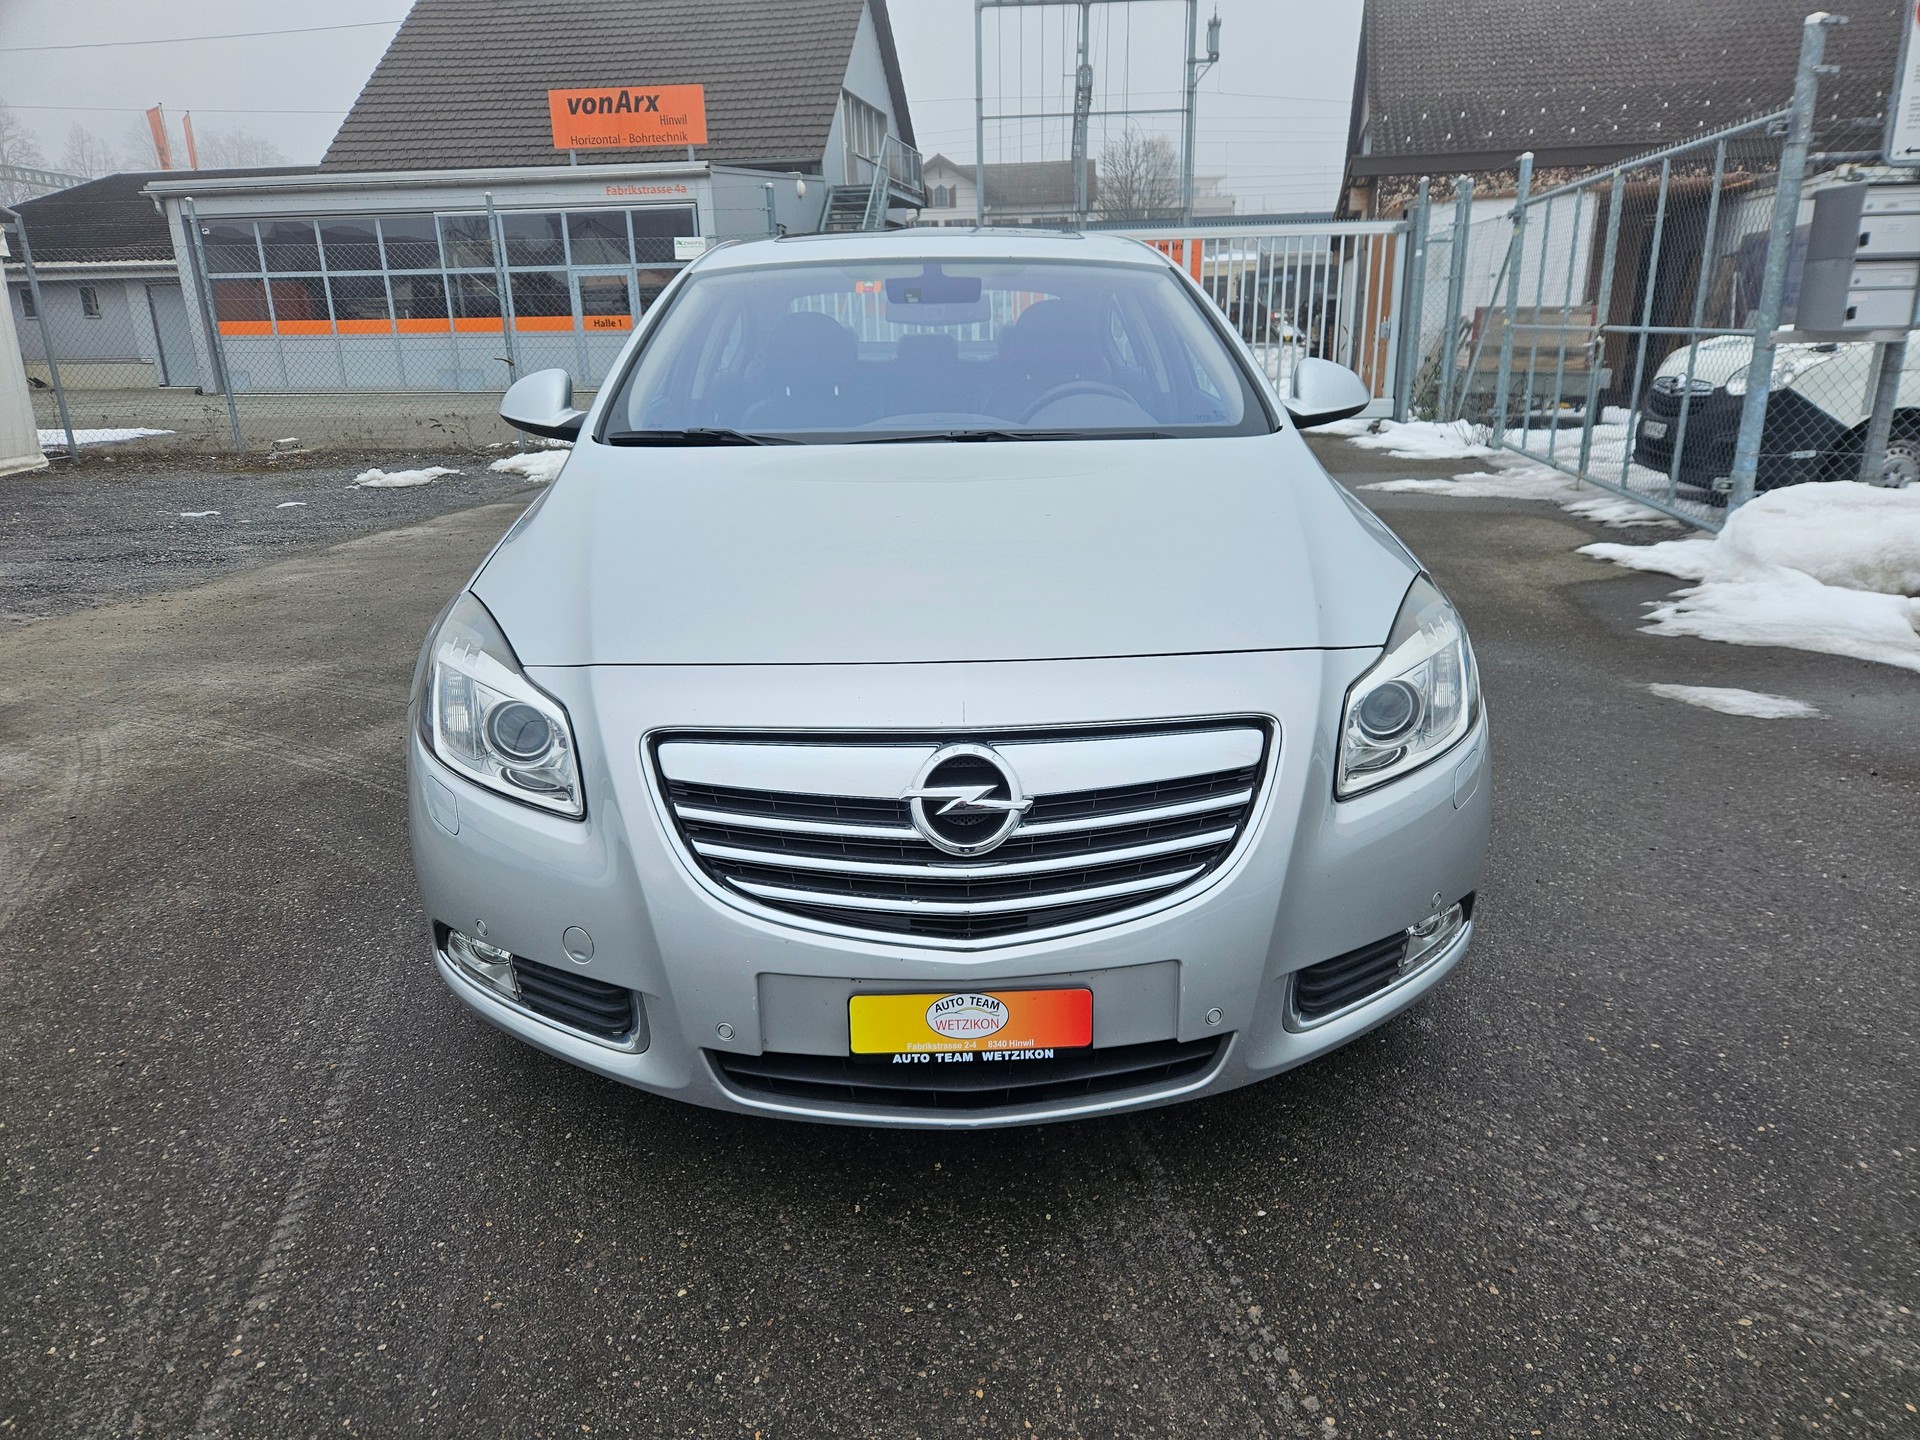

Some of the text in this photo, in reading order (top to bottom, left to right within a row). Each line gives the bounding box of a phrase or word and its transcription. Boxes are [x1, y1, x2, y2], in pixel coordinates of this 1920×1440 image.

[567, 90, 660, 115] vonArx
[659, 114, 688, 126] Hinwil
[570, 133, 621, 146] Horizontal
[629, 131, 688, 144] Bohrtechnik
[605, 183, 687, 196] Fabrikstrasse 4a
[593, 318, 622, 328] Halle 1
[933, 747, 998, 763] OPEL
[935, 996, 1000, 1013] AUTO TEAM
[934, 1018, 1000, 1031] WETZIKON
[906, 1038, 1035, 1051] Fabrikstrasse 2-4 8340 Hinwil
[892, 1048, 1054, 1064] AUTO TEAM WETZIKON
